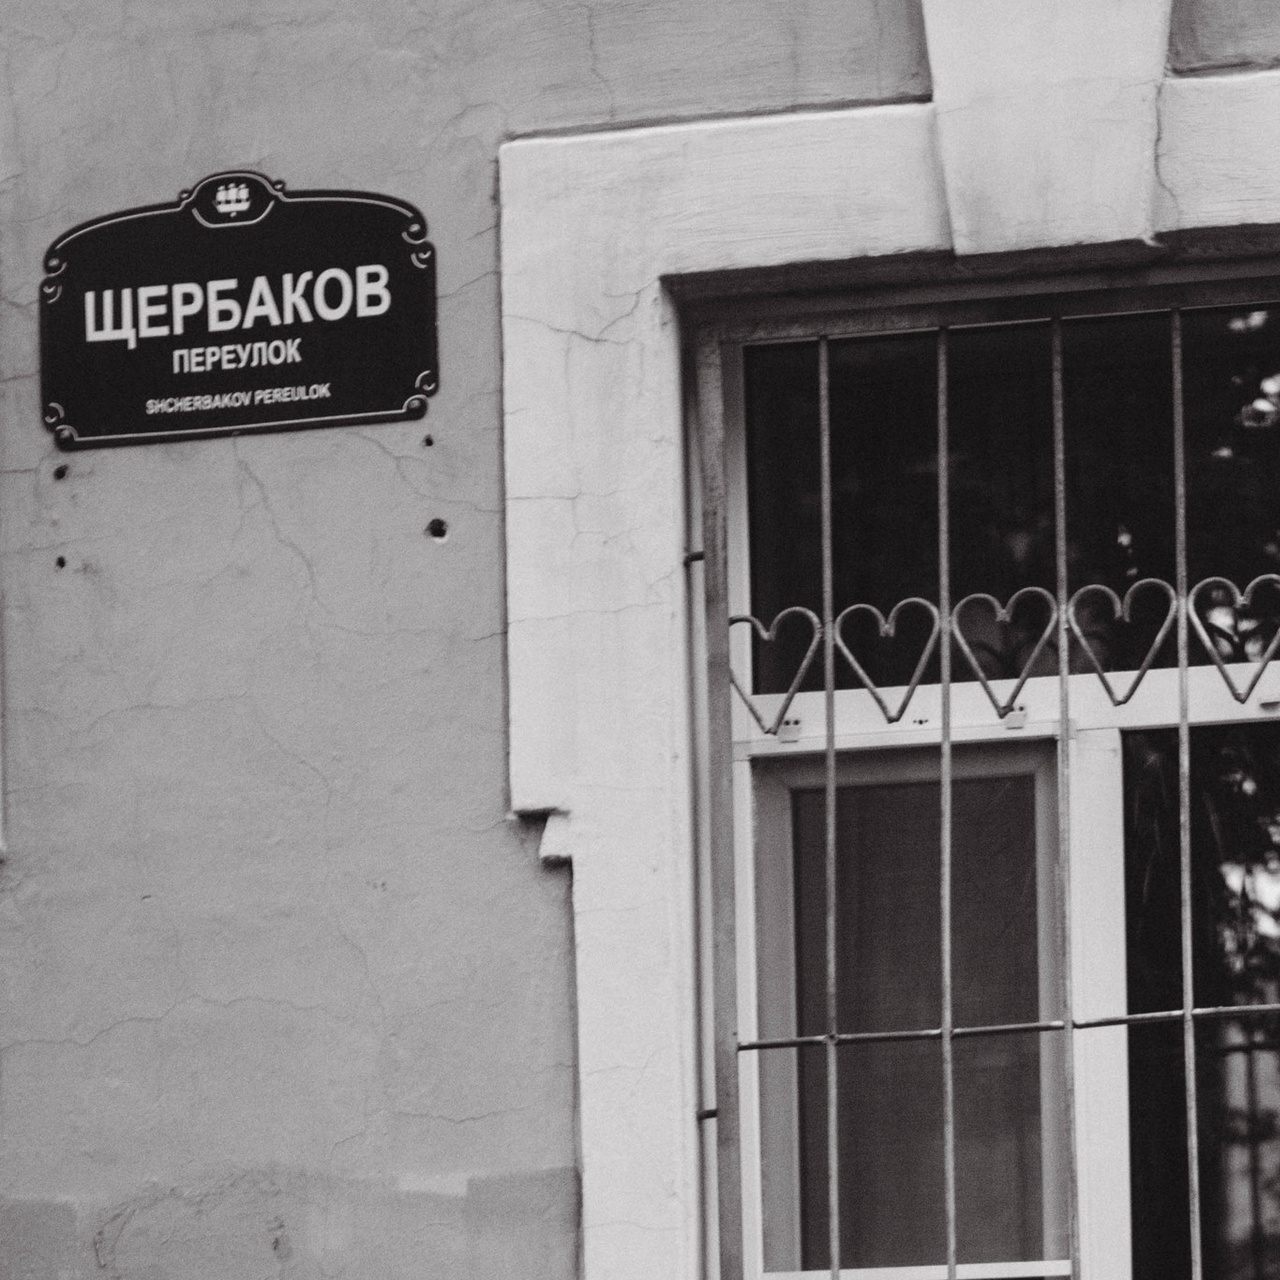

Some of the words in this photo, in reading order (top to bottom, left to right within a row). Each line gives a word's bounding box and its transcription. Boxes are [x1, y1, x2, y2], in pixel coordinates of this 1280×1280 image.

[84, 264, 392, 349] ЩЕРБАКОВ
[172, 338, 303, 375] ПЕРЕУЛОК
[145, 390, 253, 416] SHCHERBAKOV
[254, 382, 331, 406] PEREULOK
